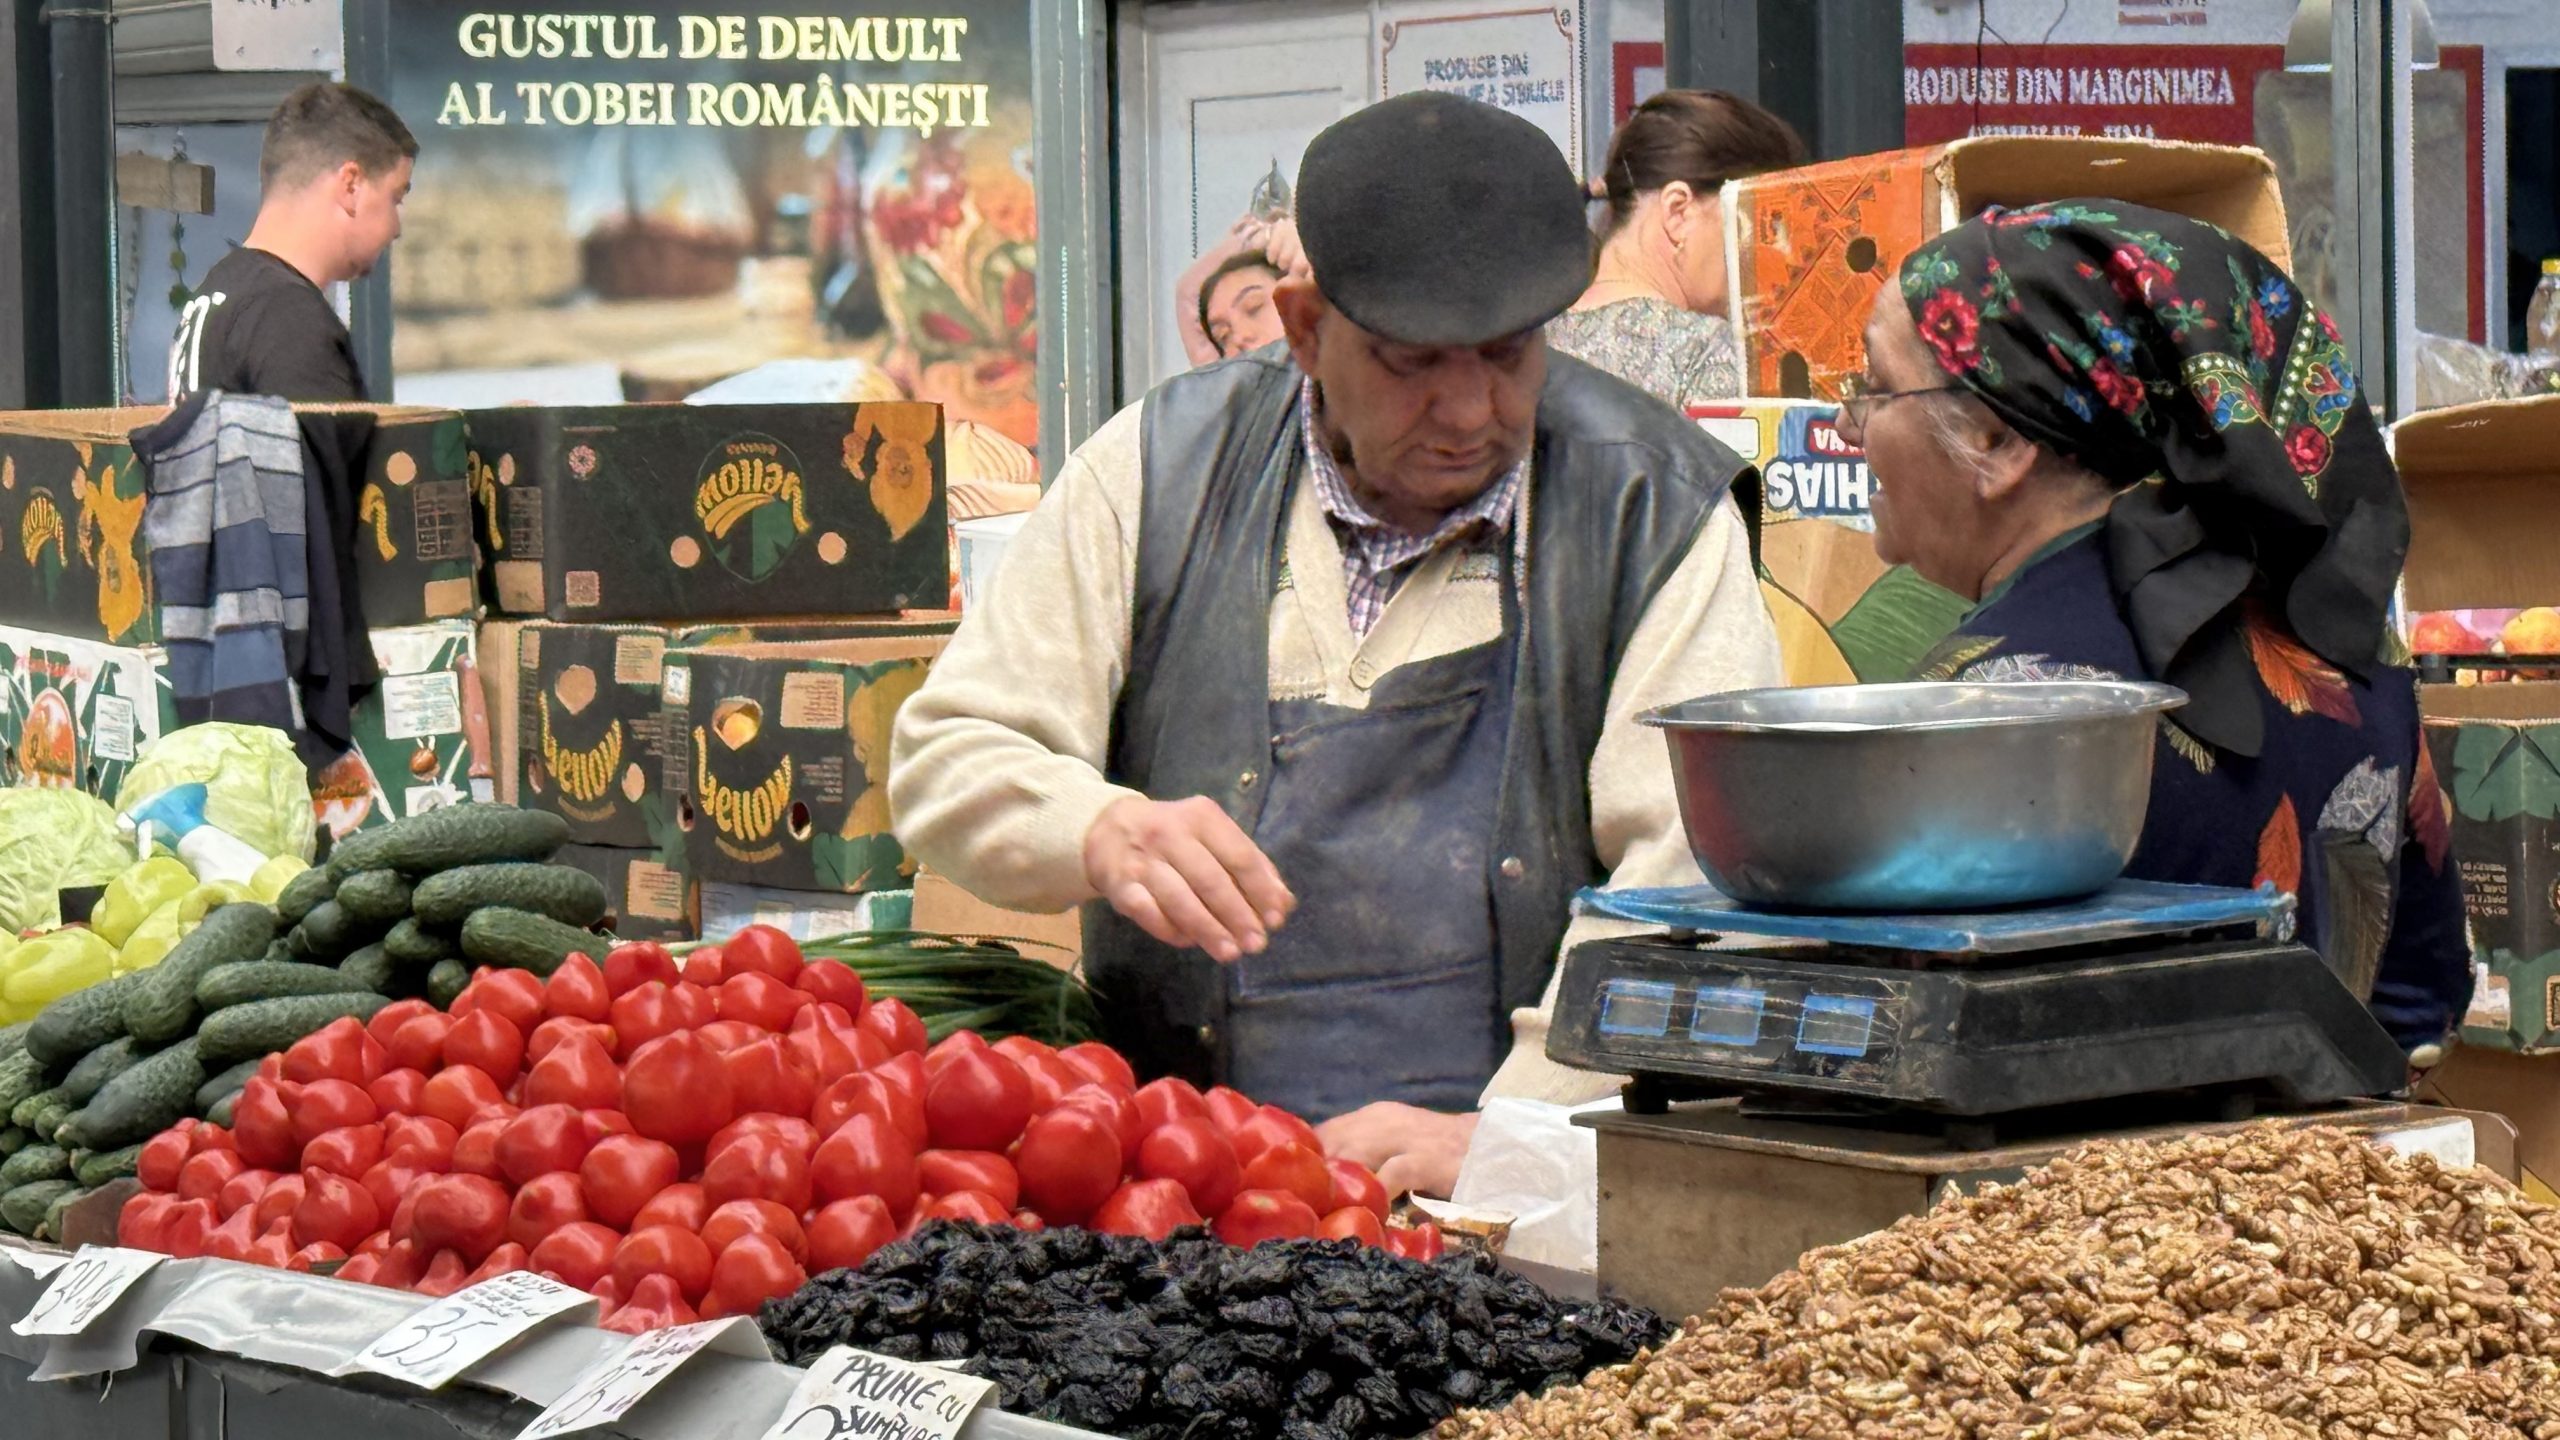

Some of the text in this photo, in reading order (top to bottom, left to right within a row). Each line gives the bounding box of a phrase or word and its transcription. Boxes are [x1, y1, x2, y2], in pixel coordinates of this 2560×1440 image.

[459, 13, 967, 61] GUSTUL DE DEMULT
[436, 72, 991, 139] AL TOBEI ROMÂNEȘTI
[1904, 66, 2235, 105] RODUSE DIN MARGINIMEA
